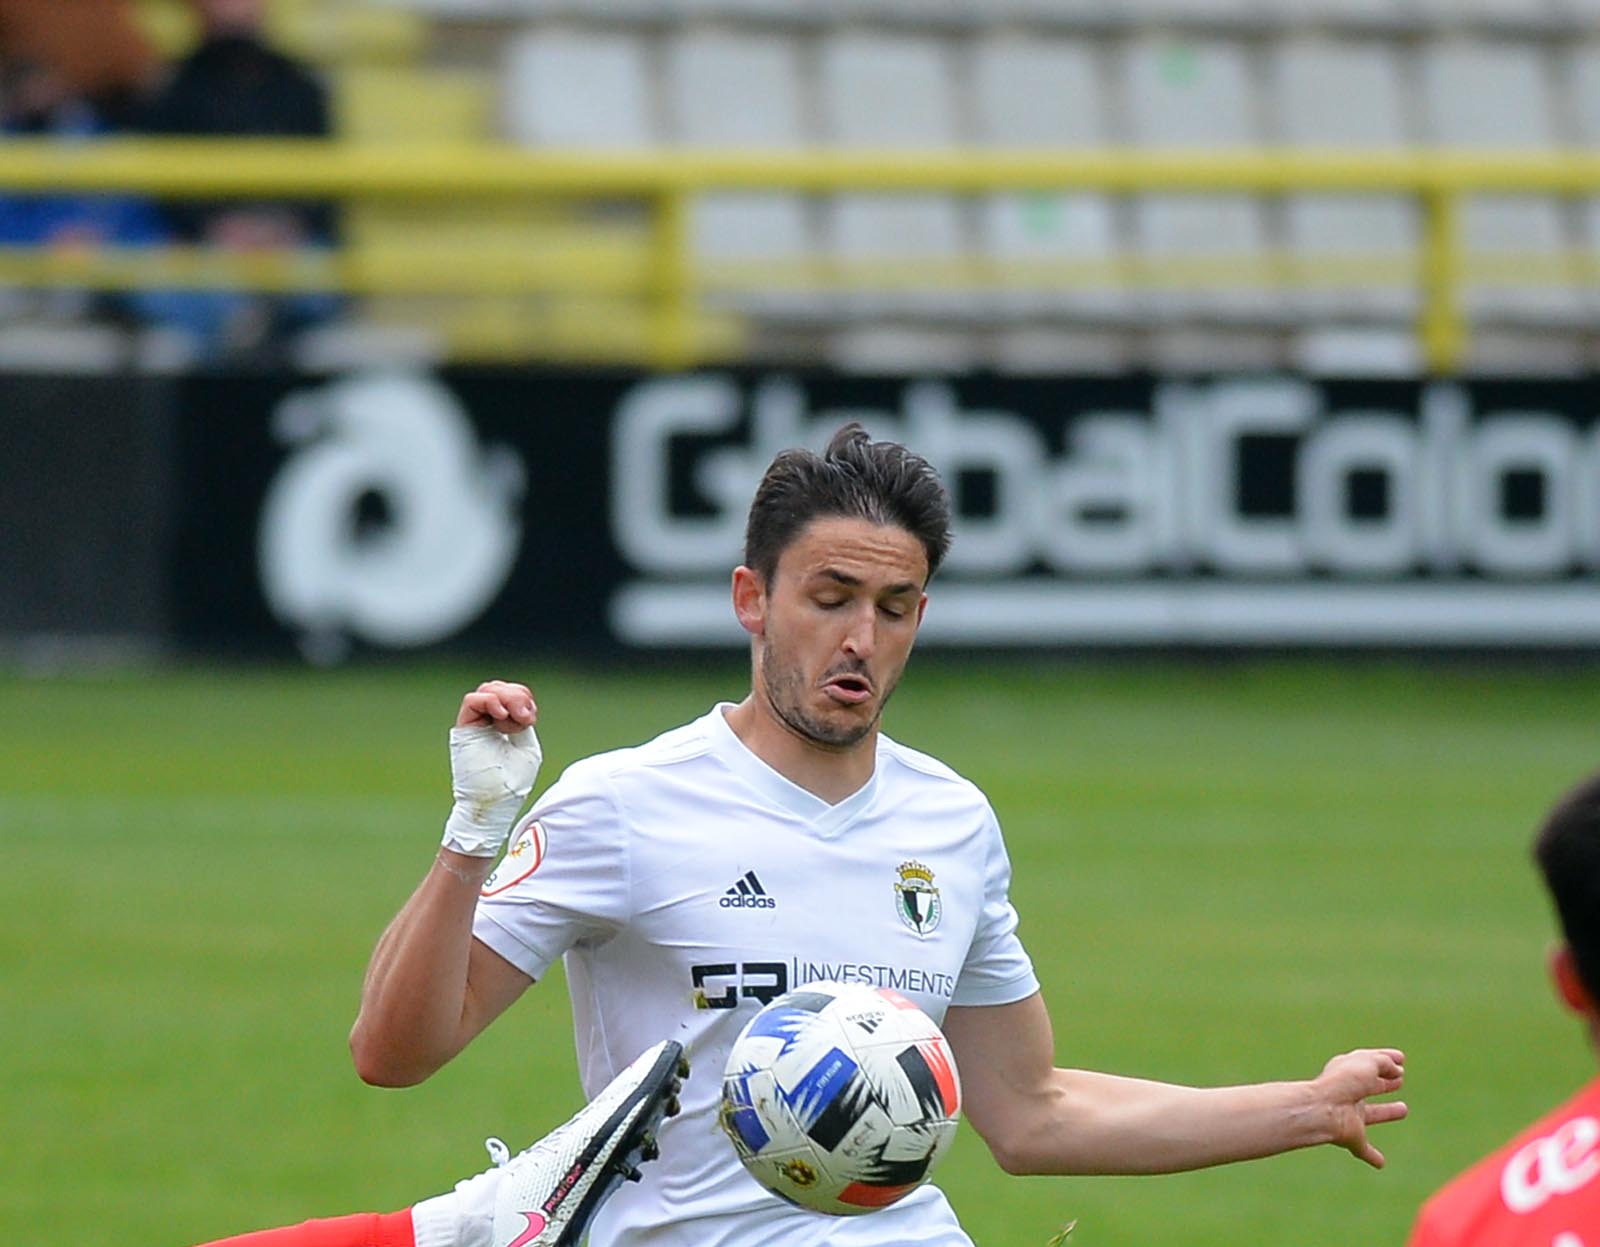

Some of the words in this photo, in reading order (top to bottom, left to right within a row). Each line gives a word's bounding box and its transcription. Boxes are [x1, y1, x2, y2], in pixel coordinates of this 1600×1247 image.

[610, 376, 1600, 574] GlbalColo
[719, 895, 776, 909] adidas
[802, 960, 955, 999] INVESTMENTS
